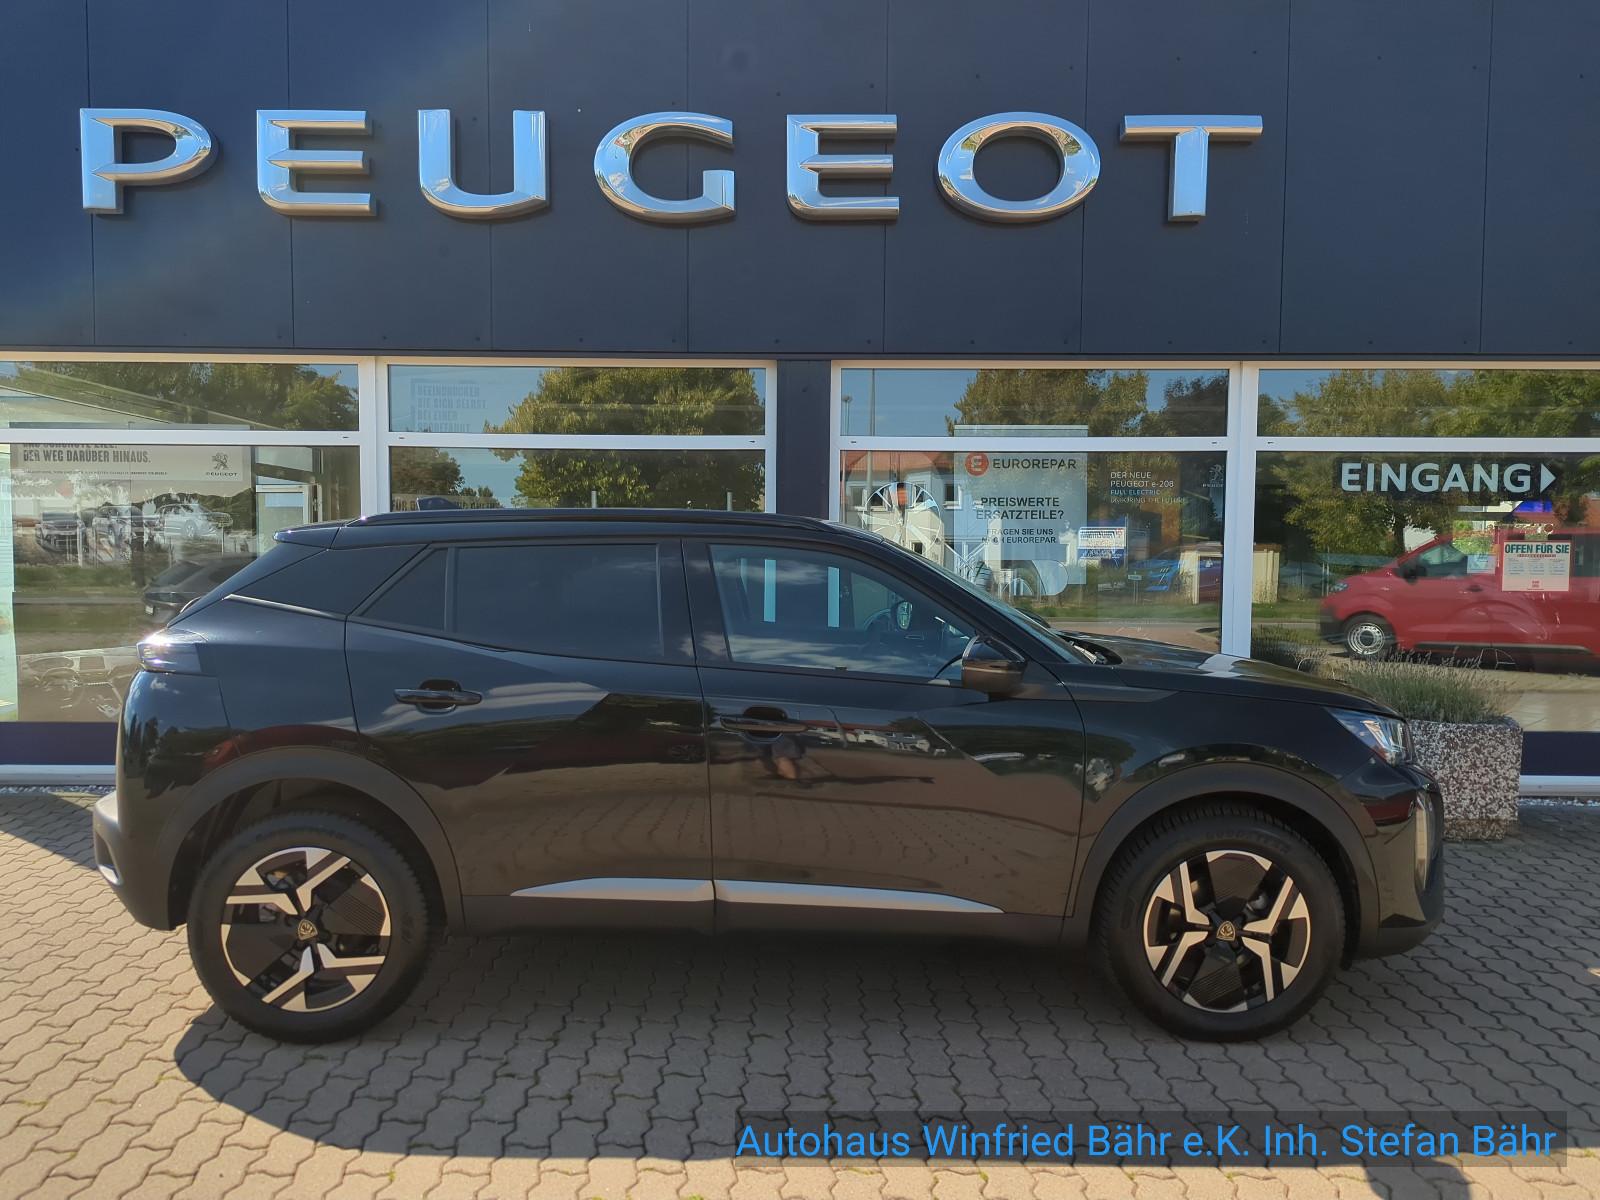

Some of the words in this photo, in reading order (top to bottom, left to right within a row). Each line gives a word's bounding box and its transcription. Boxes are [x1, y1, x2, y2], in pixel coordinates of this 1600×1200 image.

[79, 108, 1264, 222] PEUGEOT
[23, 450, 41, 462] DER
[43, 450, 64, 462] WEG
[66, 449, 110, 463] DARÜBER
[112, 450, 151, 464] HINAUS.
[992, 458, 1078, 470] EUROREPAR
[1110, 471, 1127, 479] DER
[1129, 471, 1152, 479] NEUE
[1341, 462, 1532, 493] EINGANG
[1110, 480, 1149, 488] PEUGEOT
[1151, 480, 1174, 488] e-208
[980, 497, 1060, 507] PREISWERTE
[976, 510, 1065, 520] ERSATZTEILE?
[1021, 528, 1034, 536] SIE
[1036, 528, 1054, 536] UNS
[1504, 544, 1533, 553] OFFEN
[1535, 542, 1553, 553] FÜR
[1555, 544, 1570, 554] SIE
